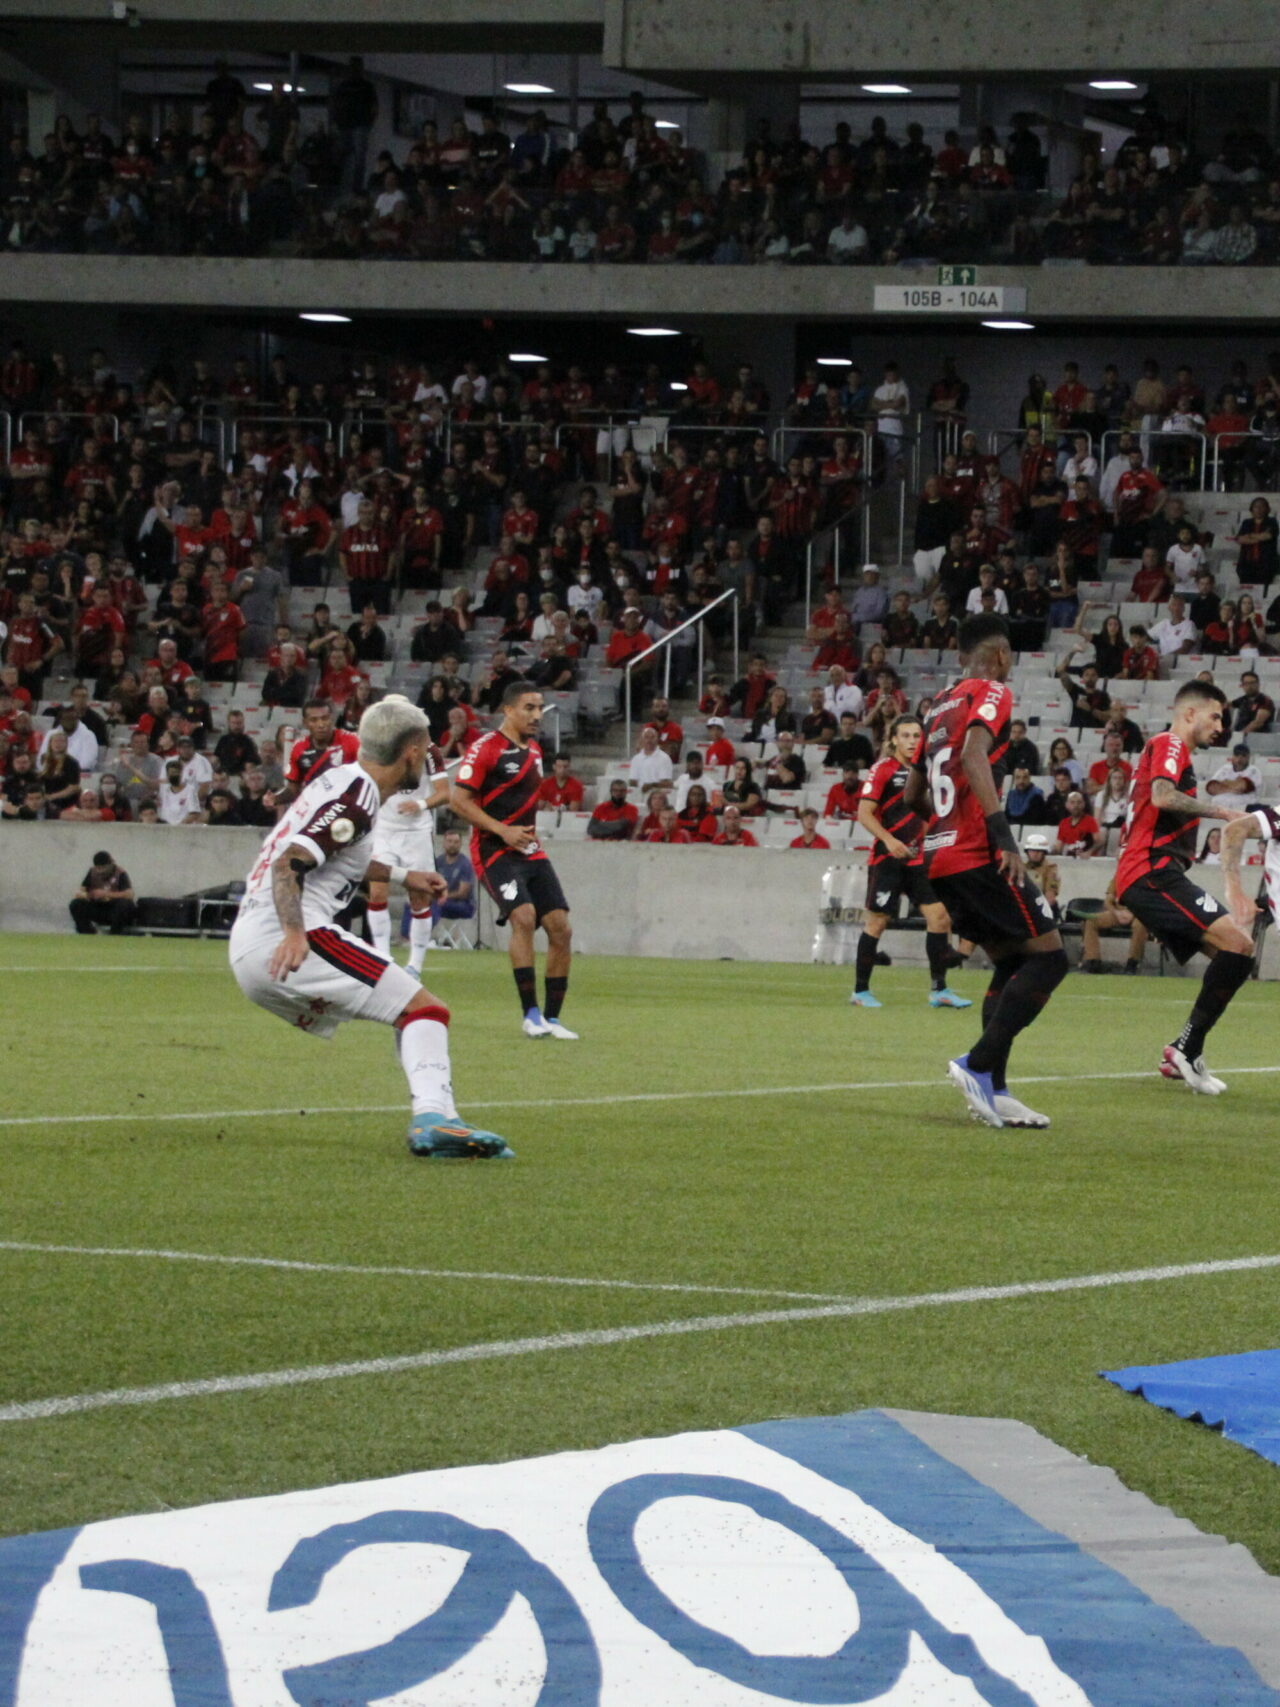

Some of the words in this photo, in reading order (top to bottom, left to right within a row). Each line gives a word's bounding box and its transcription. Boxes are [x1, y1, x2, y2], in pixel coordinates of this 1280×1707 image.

[903, 290, 942, 307] 105B
[959, 291, 998, 308] 104A
[307, 803, 347, 833] HAVAN
